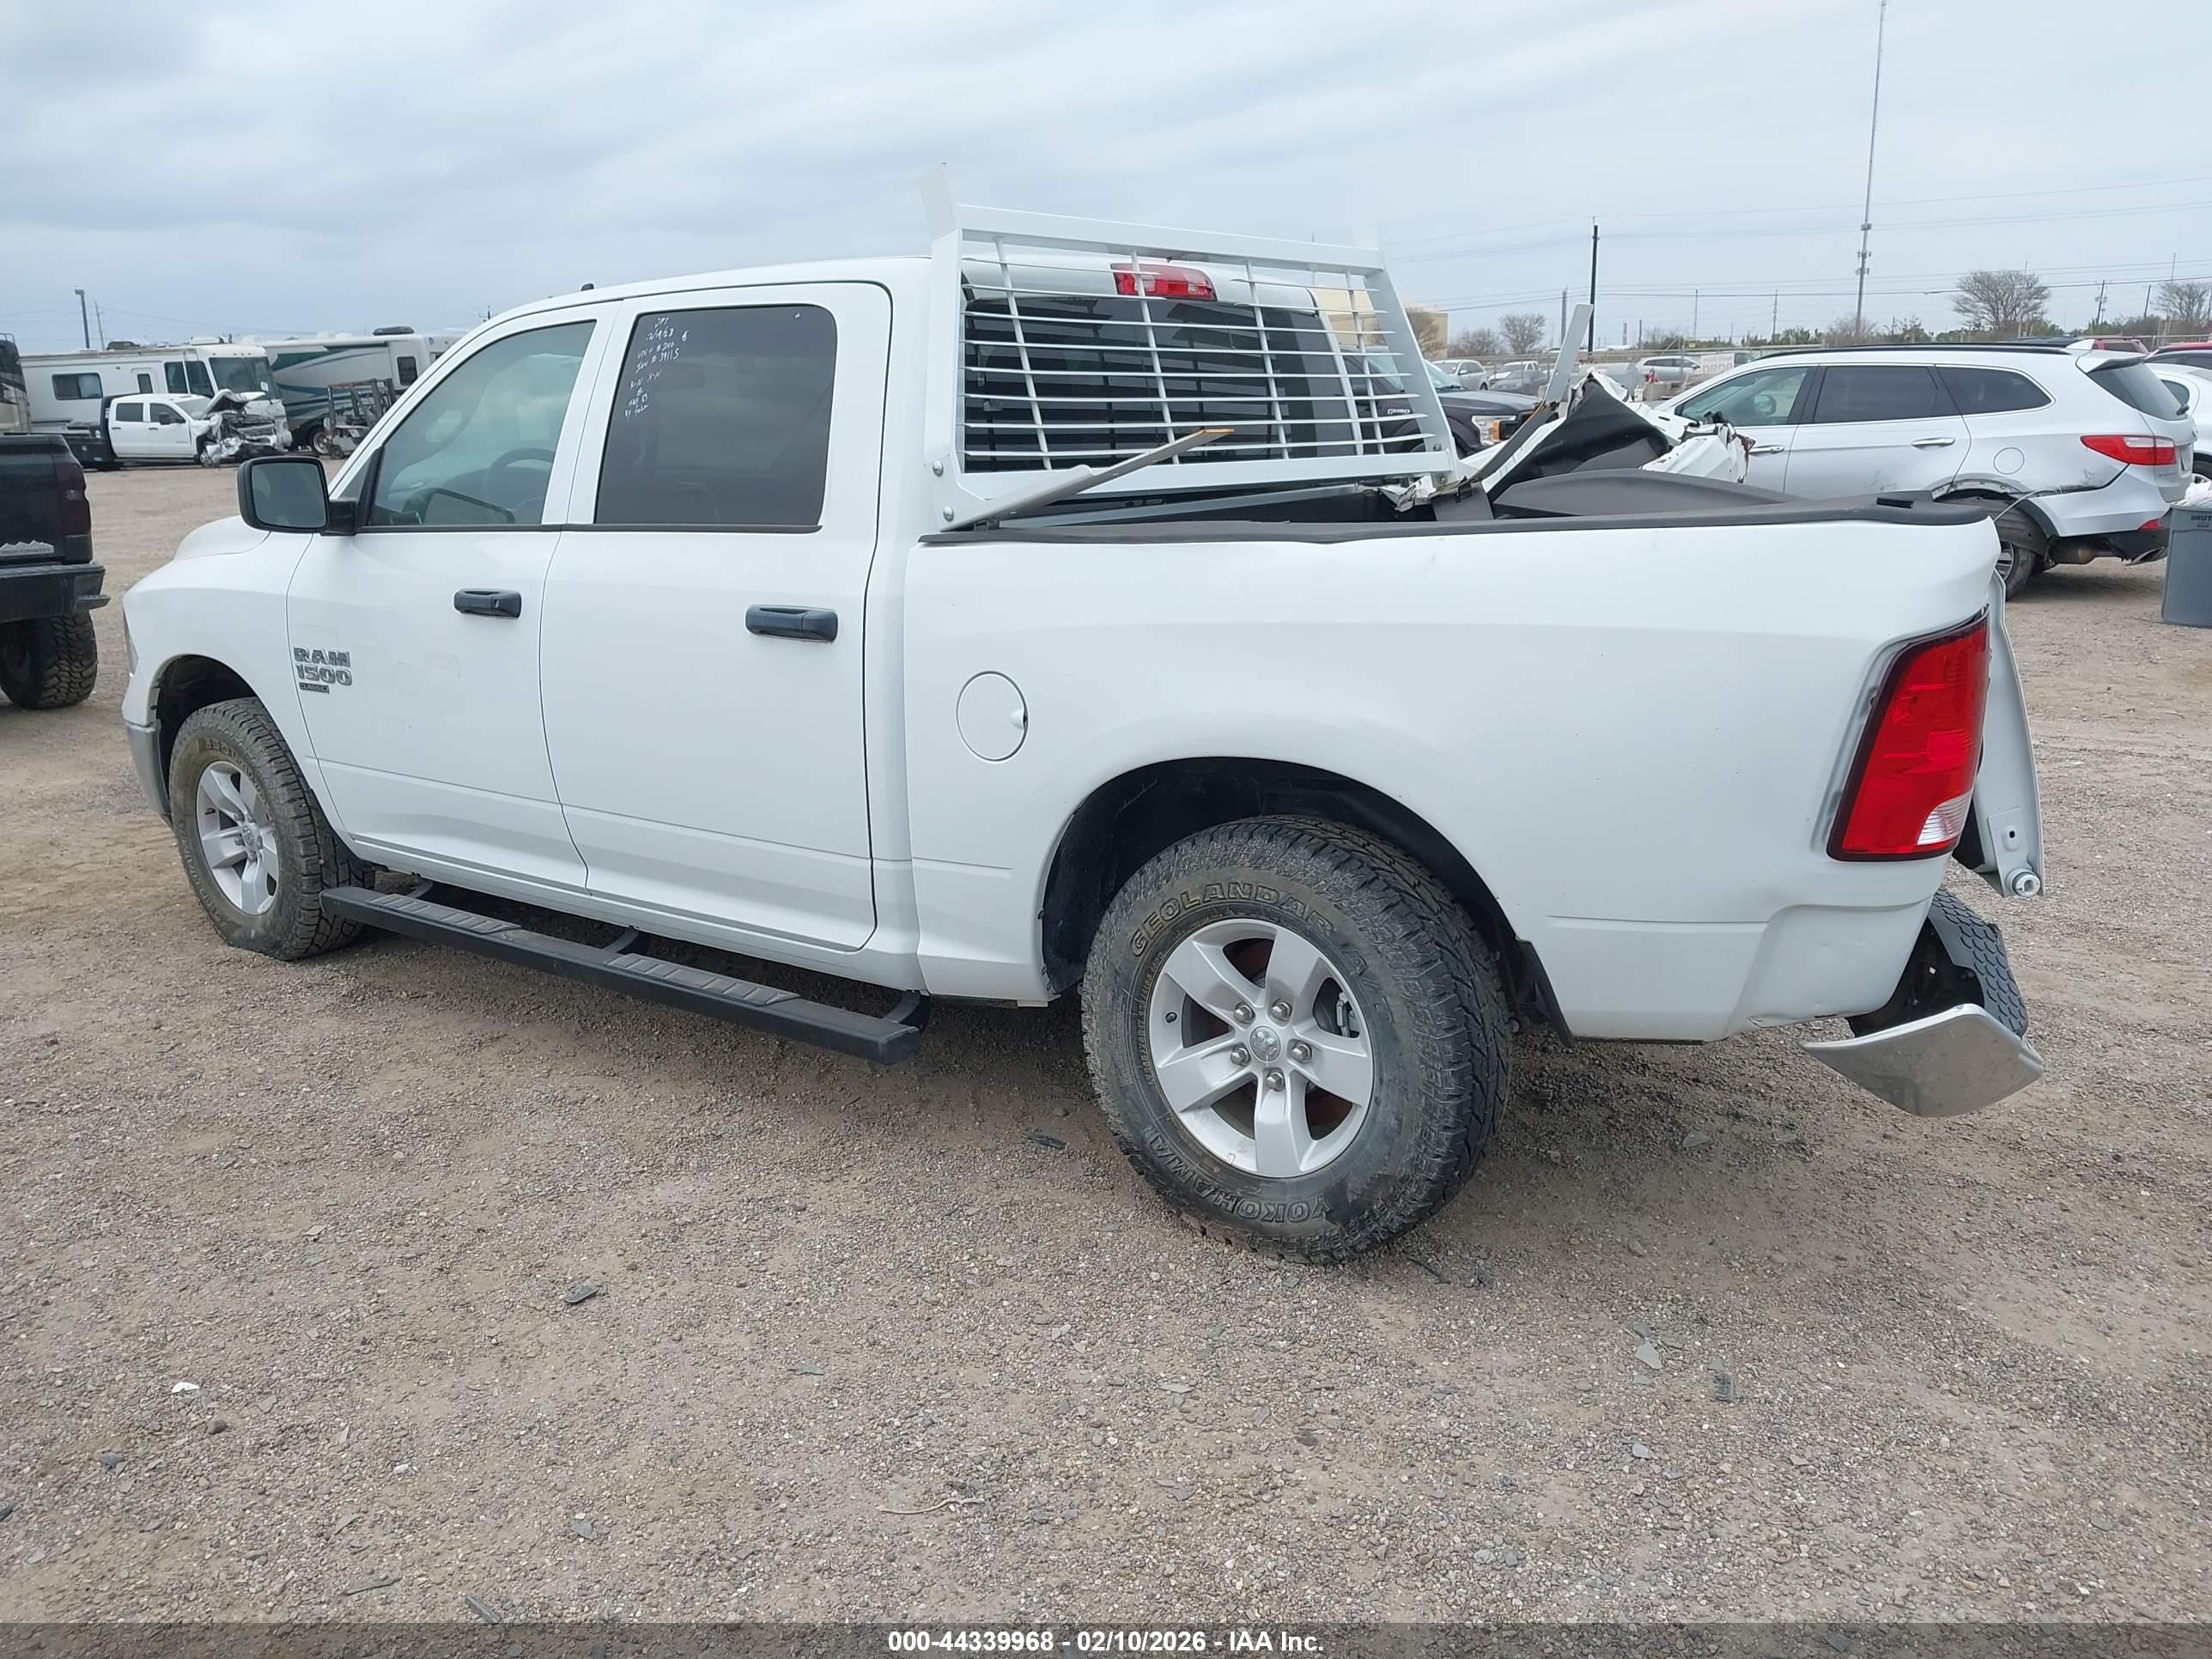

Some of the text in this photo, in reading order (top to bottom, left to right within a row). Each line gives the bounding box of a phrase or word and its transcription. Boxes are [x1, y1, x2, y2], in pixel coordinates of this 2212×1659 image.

[294, 647, 350, 668] RAM
[295, 664, 352, 686] 1500
[1130, 881, 1335, 957] GEOLANDAR
